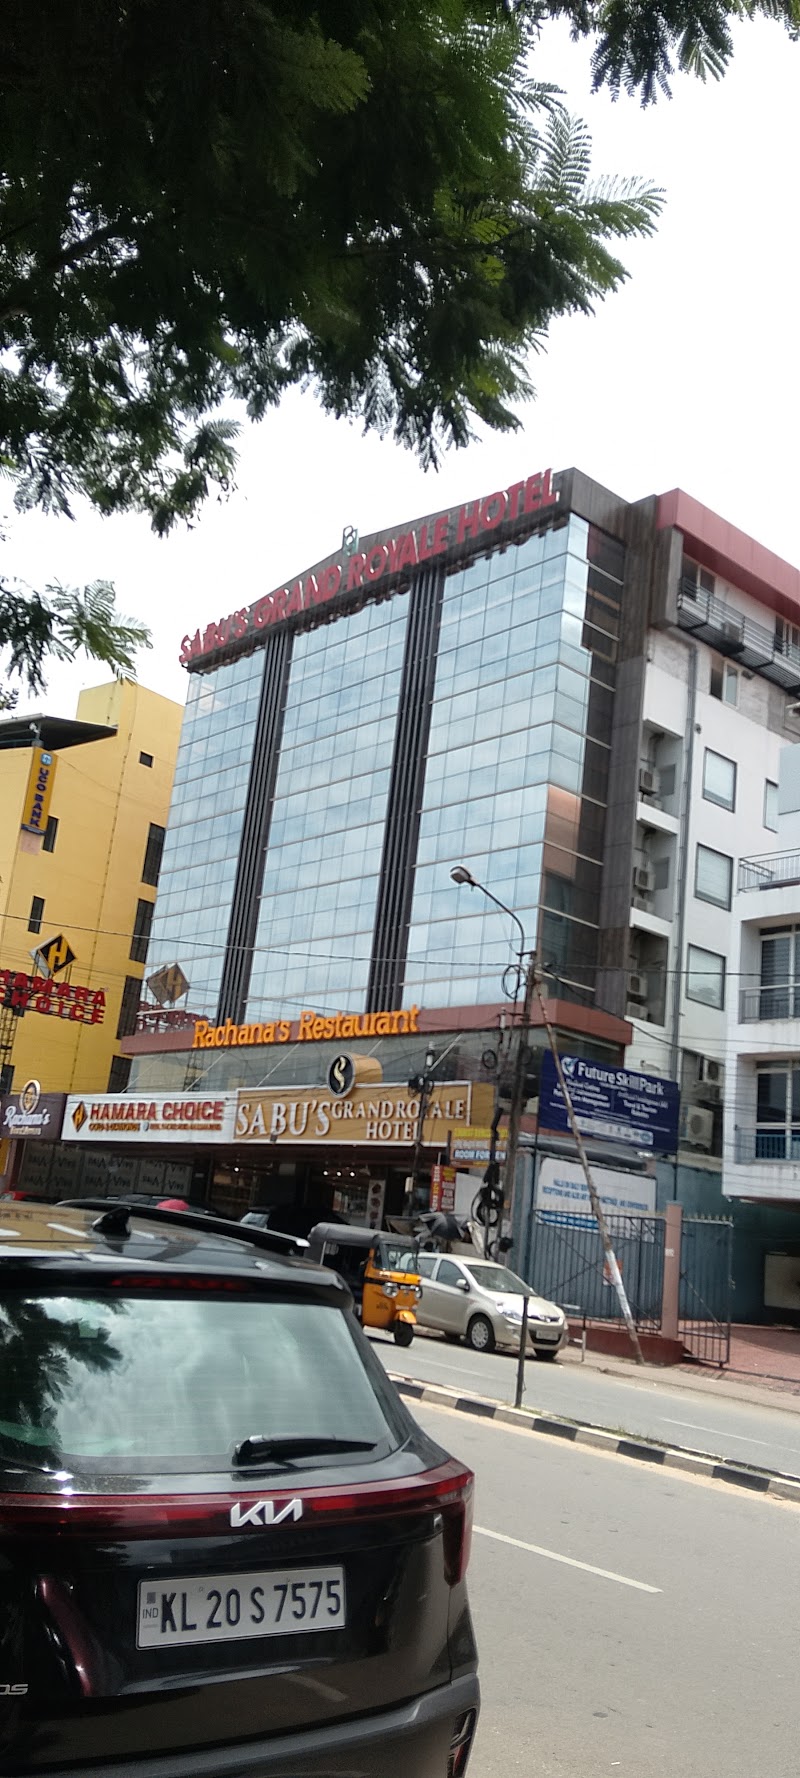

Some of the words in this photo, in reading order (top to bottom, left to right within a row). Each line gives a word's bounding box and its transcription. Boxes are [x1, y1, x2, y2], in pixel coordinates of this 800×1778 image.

[179, 606, 250, 664] SABU'S
[254, 565, 341, 628] GRAND
[347, 515, 449, 591] ROYALE
[457, 468, 559, 544] HOTEL
[37, 768, 50, 792] UCO
[29, 793, 44, 828] BANK
[191, 1017, 292, 1049] Rachana's
[297, 1003, 420, 1041] Restaurant
[89, 1102, 157, 1121] HAMARA
[161, 1101, 225, 1121] CHOICE
[235, 1099, 331, 1137] SABU'S
[142, 1607, 159, 1619] IND
[160, 1592, 197, 1633] KL
[206, 1588, 241, 1629] 20
[250, 1586, 265, 1623] S
[273, 1579, 341, 1623] 7575
